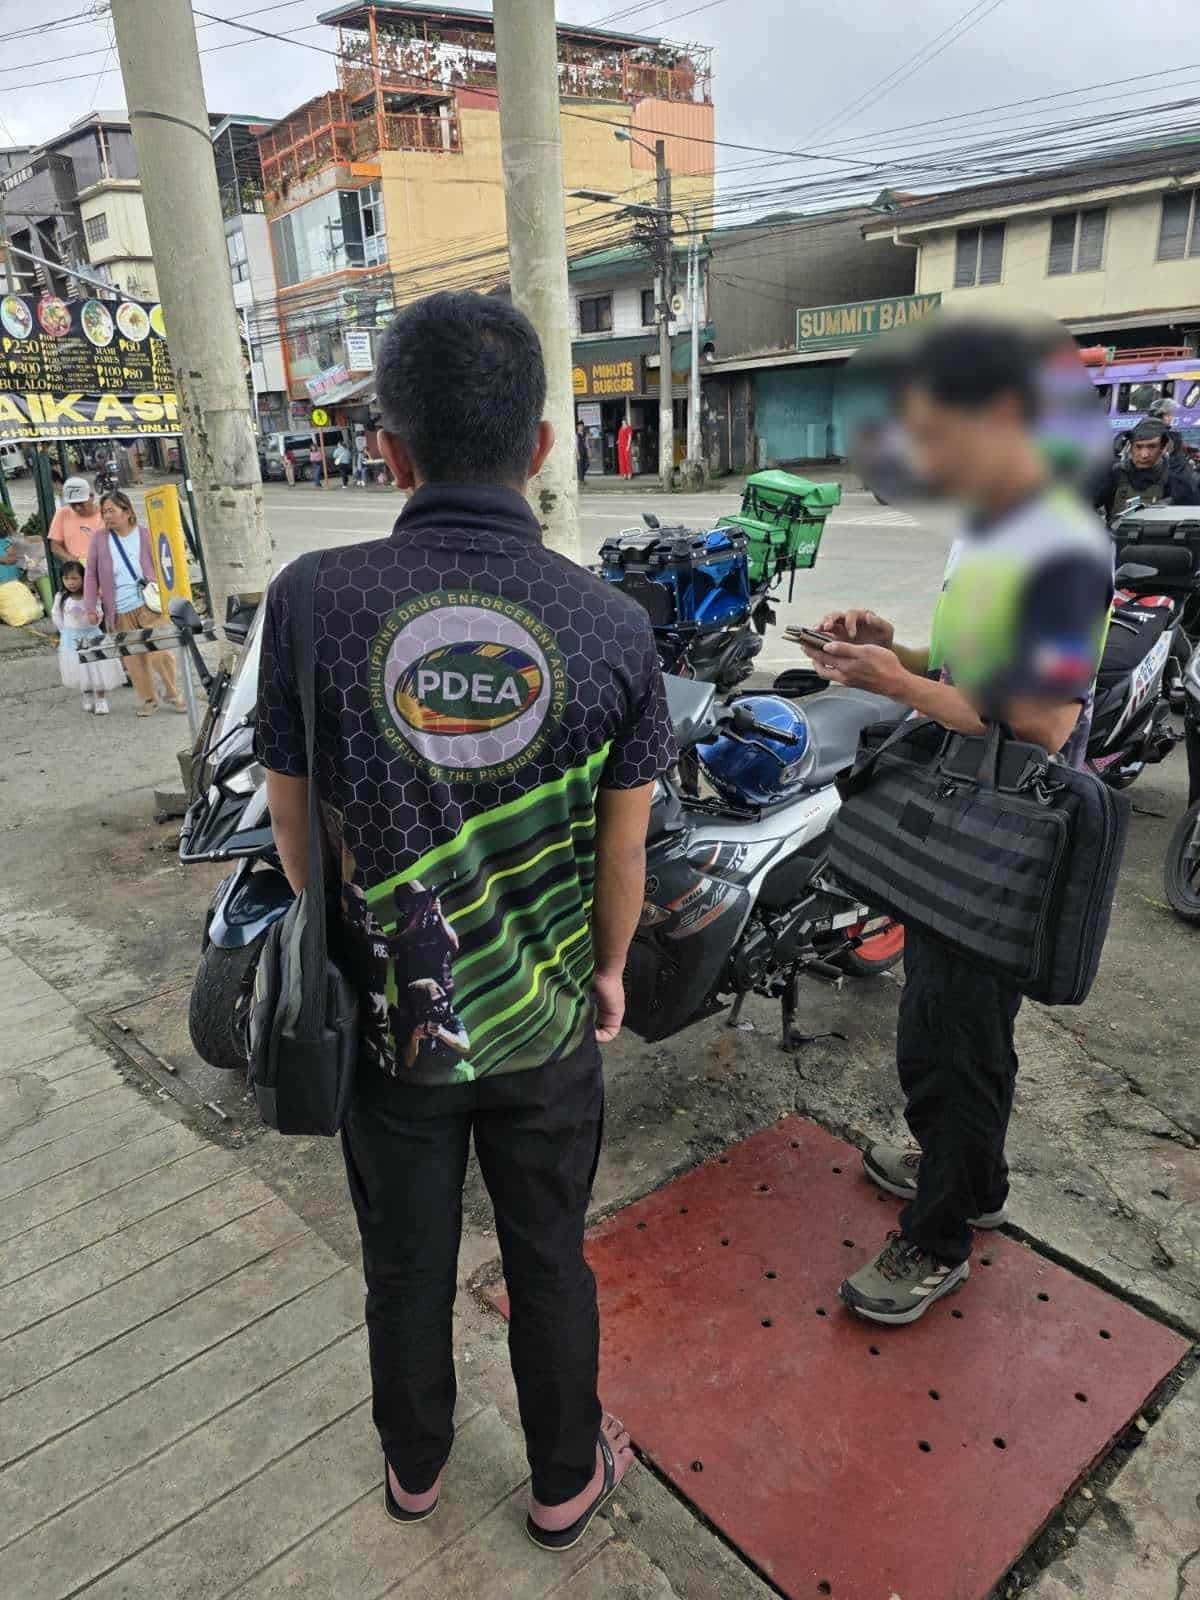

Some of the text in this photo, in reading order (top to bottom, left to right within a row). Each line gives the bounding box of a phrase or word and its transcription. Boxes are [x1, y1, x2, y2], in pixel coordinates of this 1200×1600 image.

[801, 306, 874, 338] SUMMIT
[592, 361, 634, 378] MINUTE
[592, 378, 634, 394] BURGER
[61, 425, 110, 434] INSIDE
[371, 593, 565, 721] PHILIPPINE DRUG ENFORCEMENT AGENCY
[417, 669, 523, 707] PDEA
[384, 727, 546, 782] OFFICE OF THE PRESIDENT
